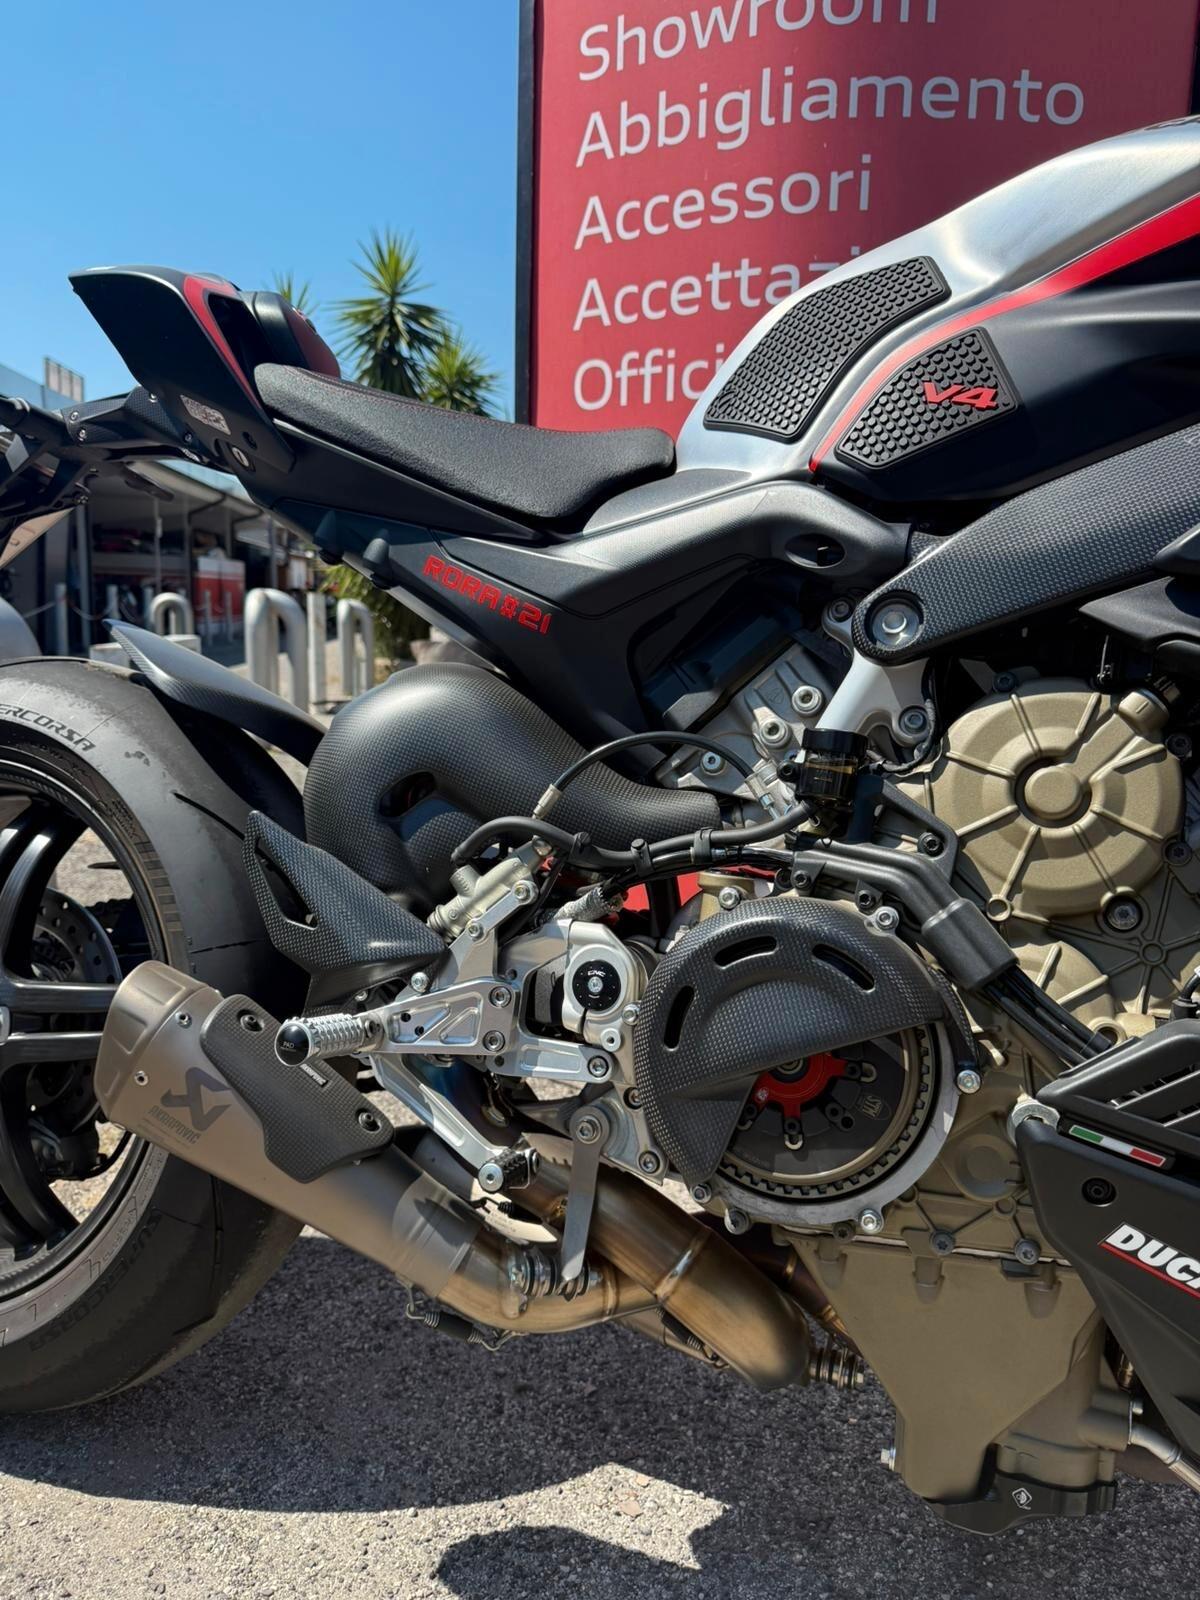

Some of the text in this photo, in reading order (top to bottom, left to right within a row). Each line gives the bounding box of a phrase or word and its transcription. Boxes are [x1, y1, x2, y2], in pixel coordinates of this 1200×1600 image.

[579, 0, 937, 81] Showroom
[575, 66, 1084, 168] Abbigliamento
[574, 154, 871, 250] Accessori
[572, 247, 860, 331] Accetta
[924, 382, 998, 411] V4
[1105, 1224, 1200, 1289] DUC
